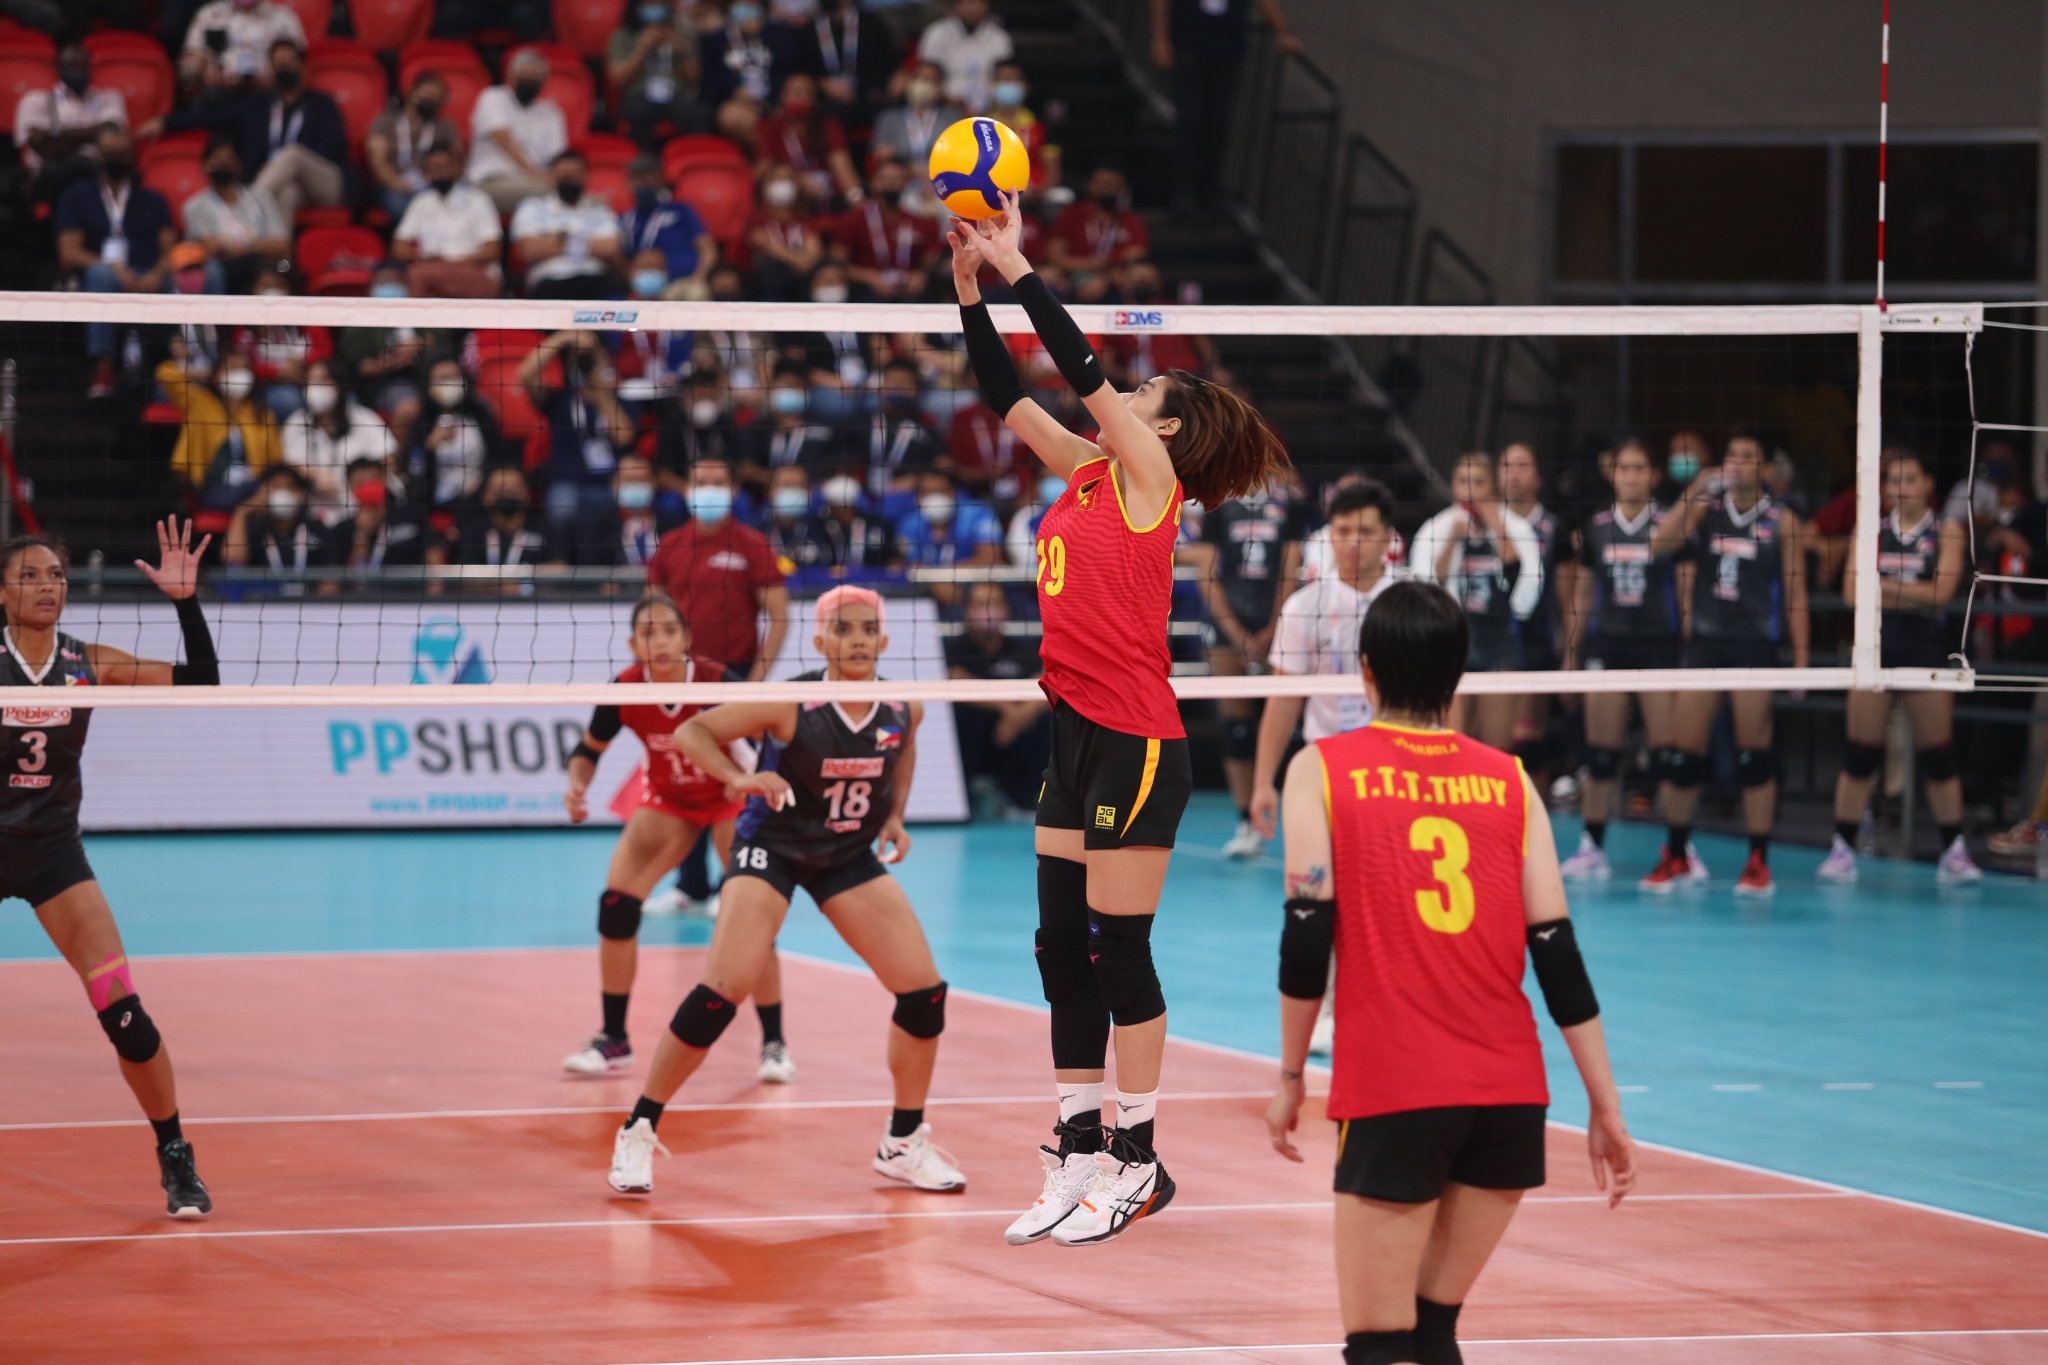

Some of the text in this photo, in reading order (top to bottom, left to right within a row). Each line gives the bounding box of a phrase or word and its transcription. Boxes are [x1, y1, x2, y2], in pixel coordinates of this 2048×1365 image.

[1127, 311, 1163, 326] DMS
[18, 730, 48, 773] 3
[326, 718, 586, 776] PPSHOP
[823, 780, 873, 820] 18
[1350, 766, 1507, 807] T.T.T.THUY
[1097, 815, 1112, 825] BL
[1098, 807, 1114, 816] JG
[736, 846, 769, 870] 18
[1409, 816, 1476, 935] 3
